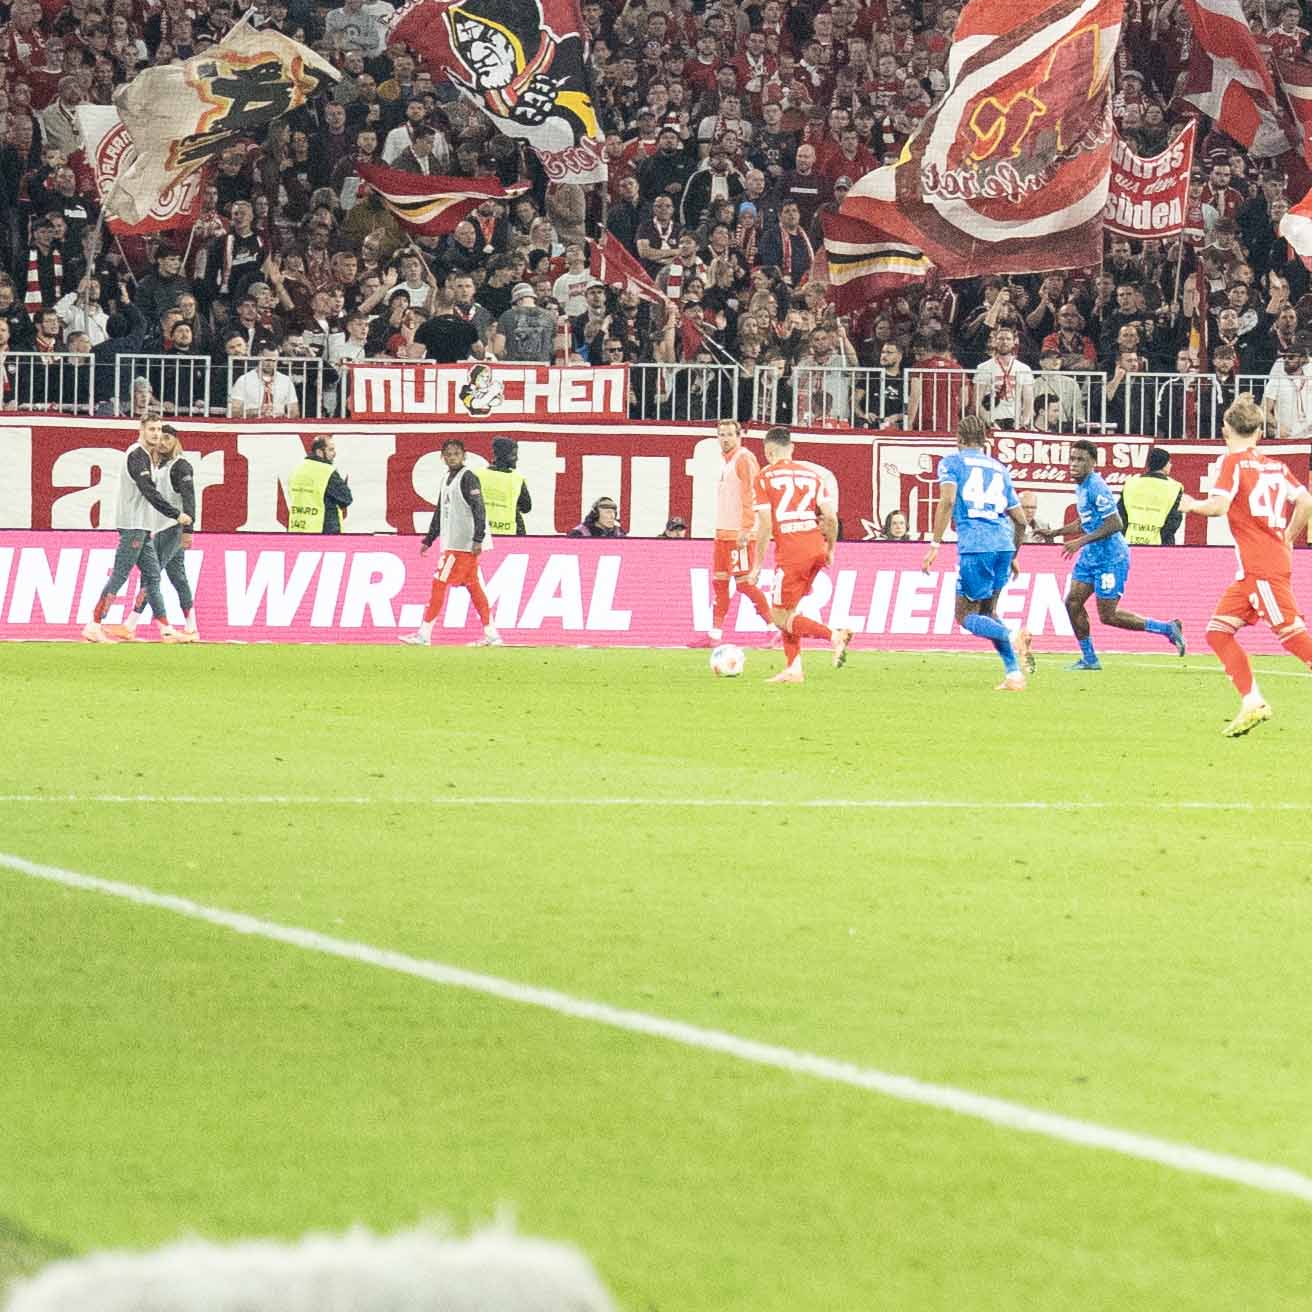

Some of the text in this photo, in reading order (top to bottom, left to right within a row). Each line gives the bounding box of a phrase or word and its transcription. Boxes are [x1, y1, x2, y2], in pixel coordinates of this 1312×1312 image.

[998, 438, 1107, 467] Sektin
[1112, 442, 1149, 469] SV
[770, 476, 818, 522] 22
[962, 467, 1008, 510] 44
